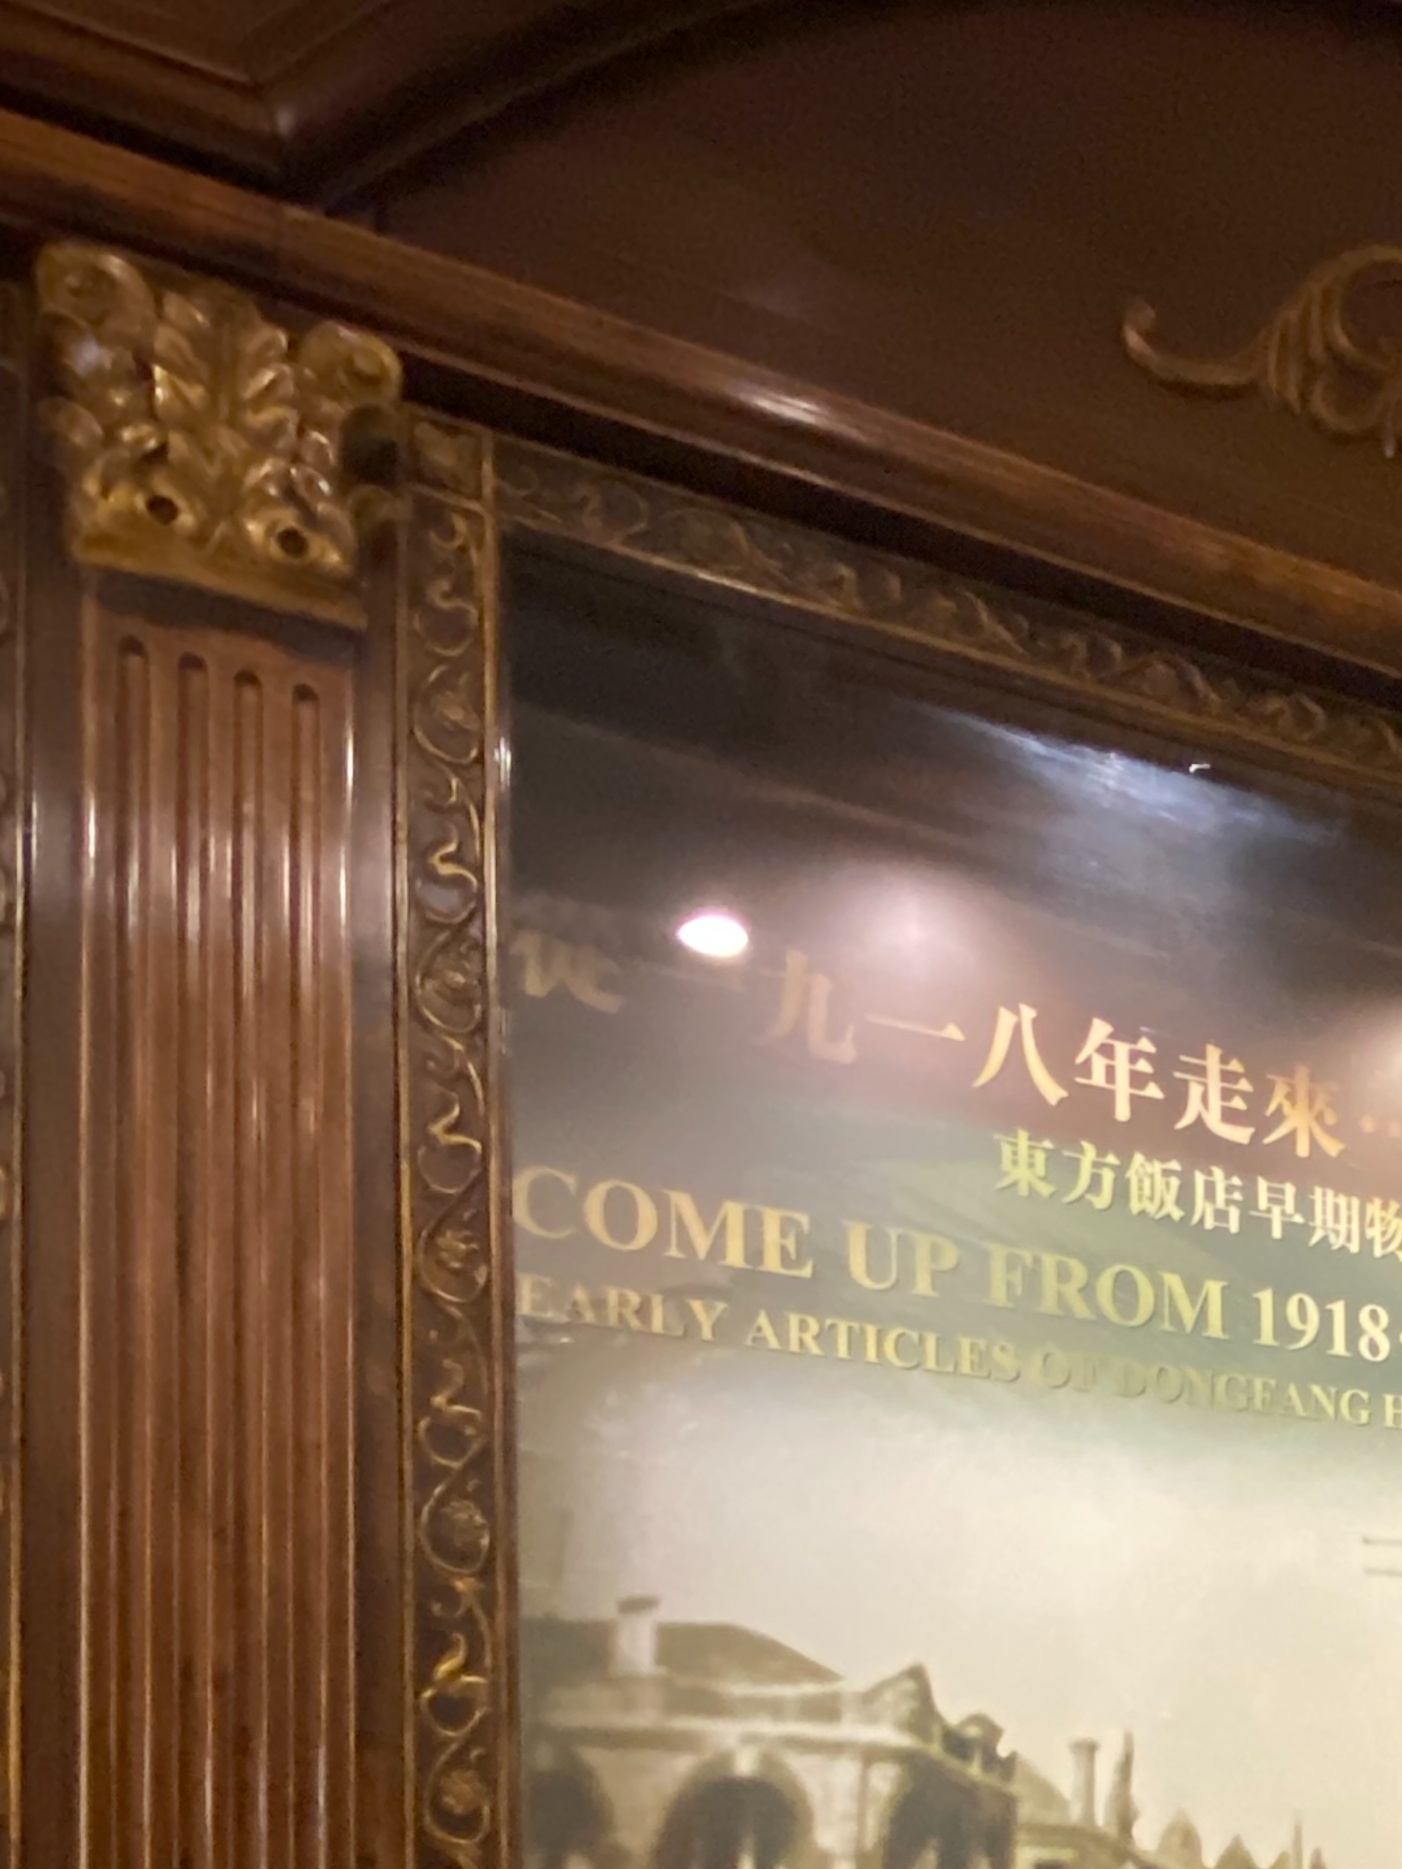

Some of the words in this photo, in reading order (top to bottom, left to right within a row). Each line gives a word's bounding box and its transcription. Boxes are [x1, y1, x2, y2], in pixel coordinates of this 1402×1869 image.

[512, 1164, 816, 1280] COME
[845, 1220, 960, 1298] UP
[986, 1243, 1230, 1339] FROM
[516, 1274, 728, 1342] EARLY
[746, 1309, 1021, 1383] ARTICLES
[1040, 1348, 1103, 1394] OF
[1116, 1362, 1372, 1426] DONGFANG
